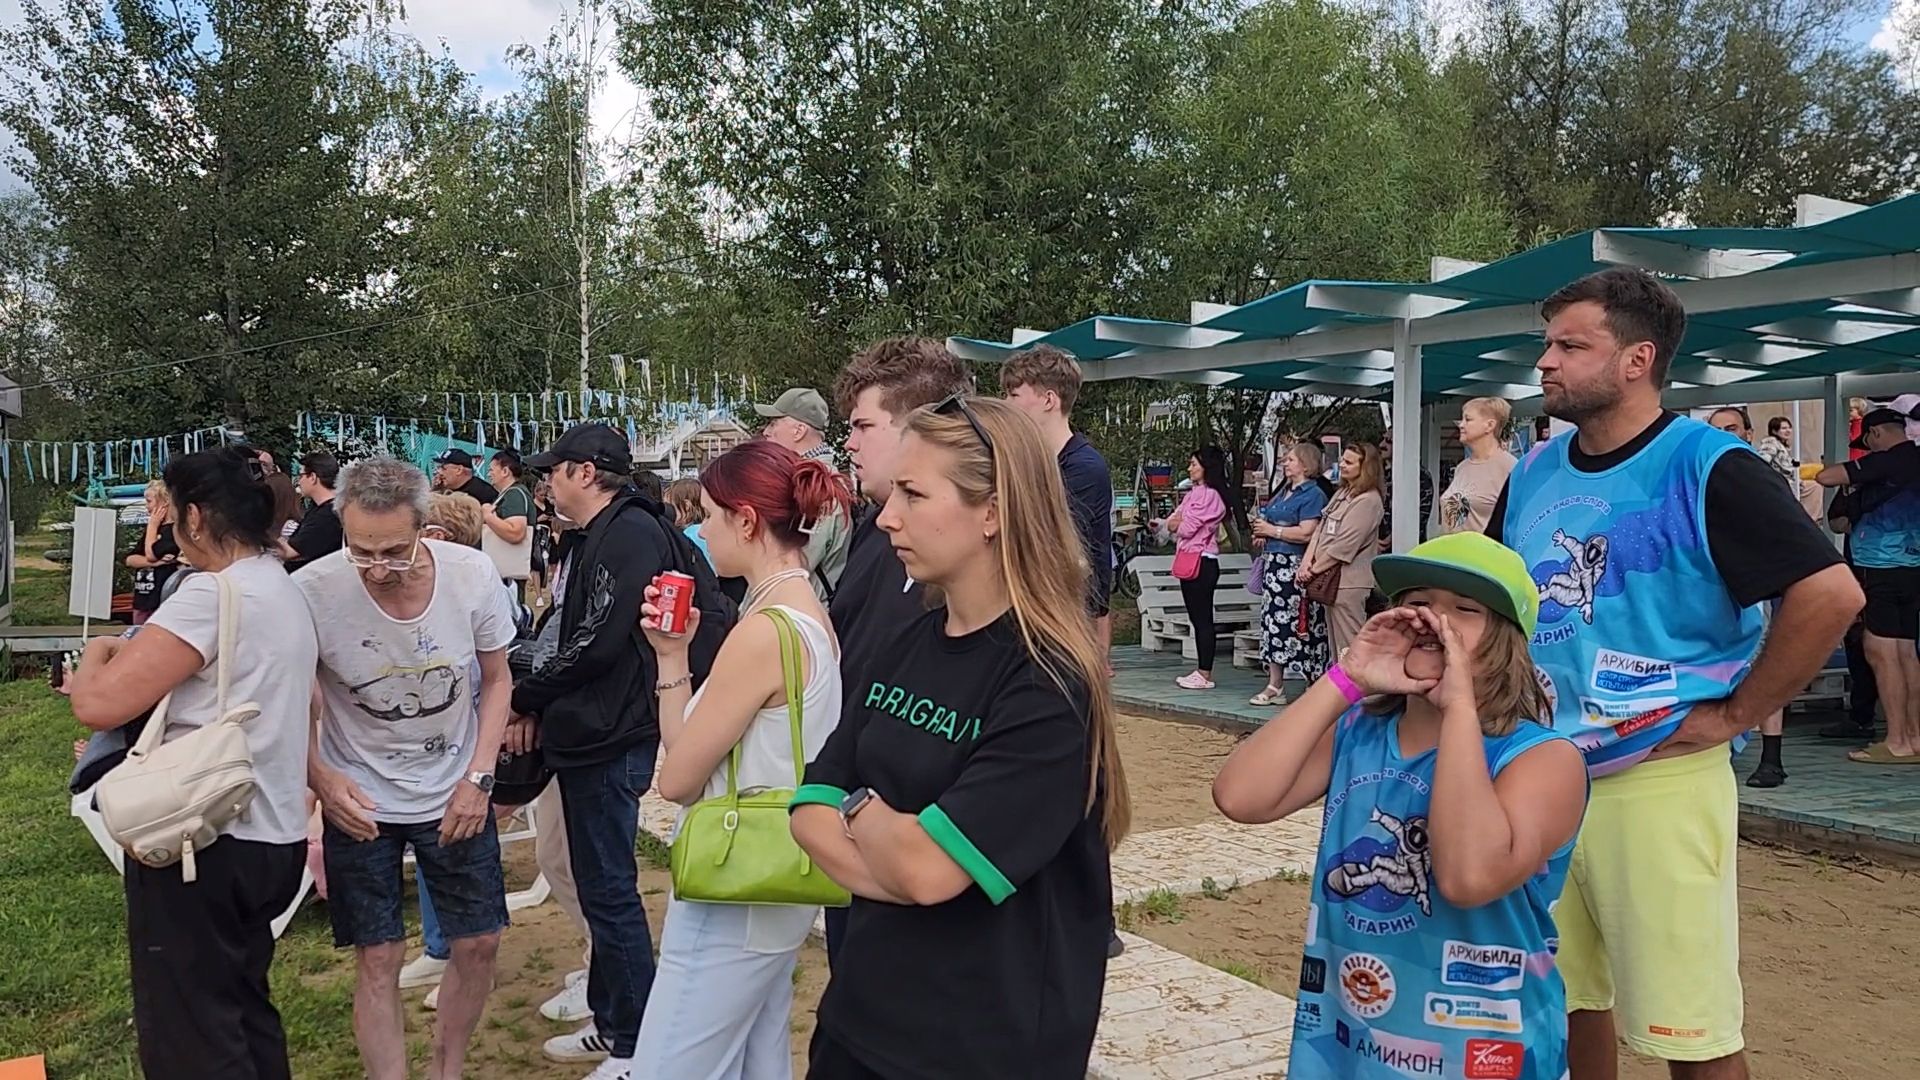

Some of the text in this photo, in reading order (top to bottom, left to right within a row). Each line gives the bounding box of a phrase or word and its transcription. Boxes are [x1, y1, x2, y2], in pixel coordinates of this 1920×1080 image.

[1532, 623, 1575, 644] АРИН
[1447, 944, 1522, 967] АРХИБИЛД
[1356, 1038, 1443, 1075] АМИКОН
